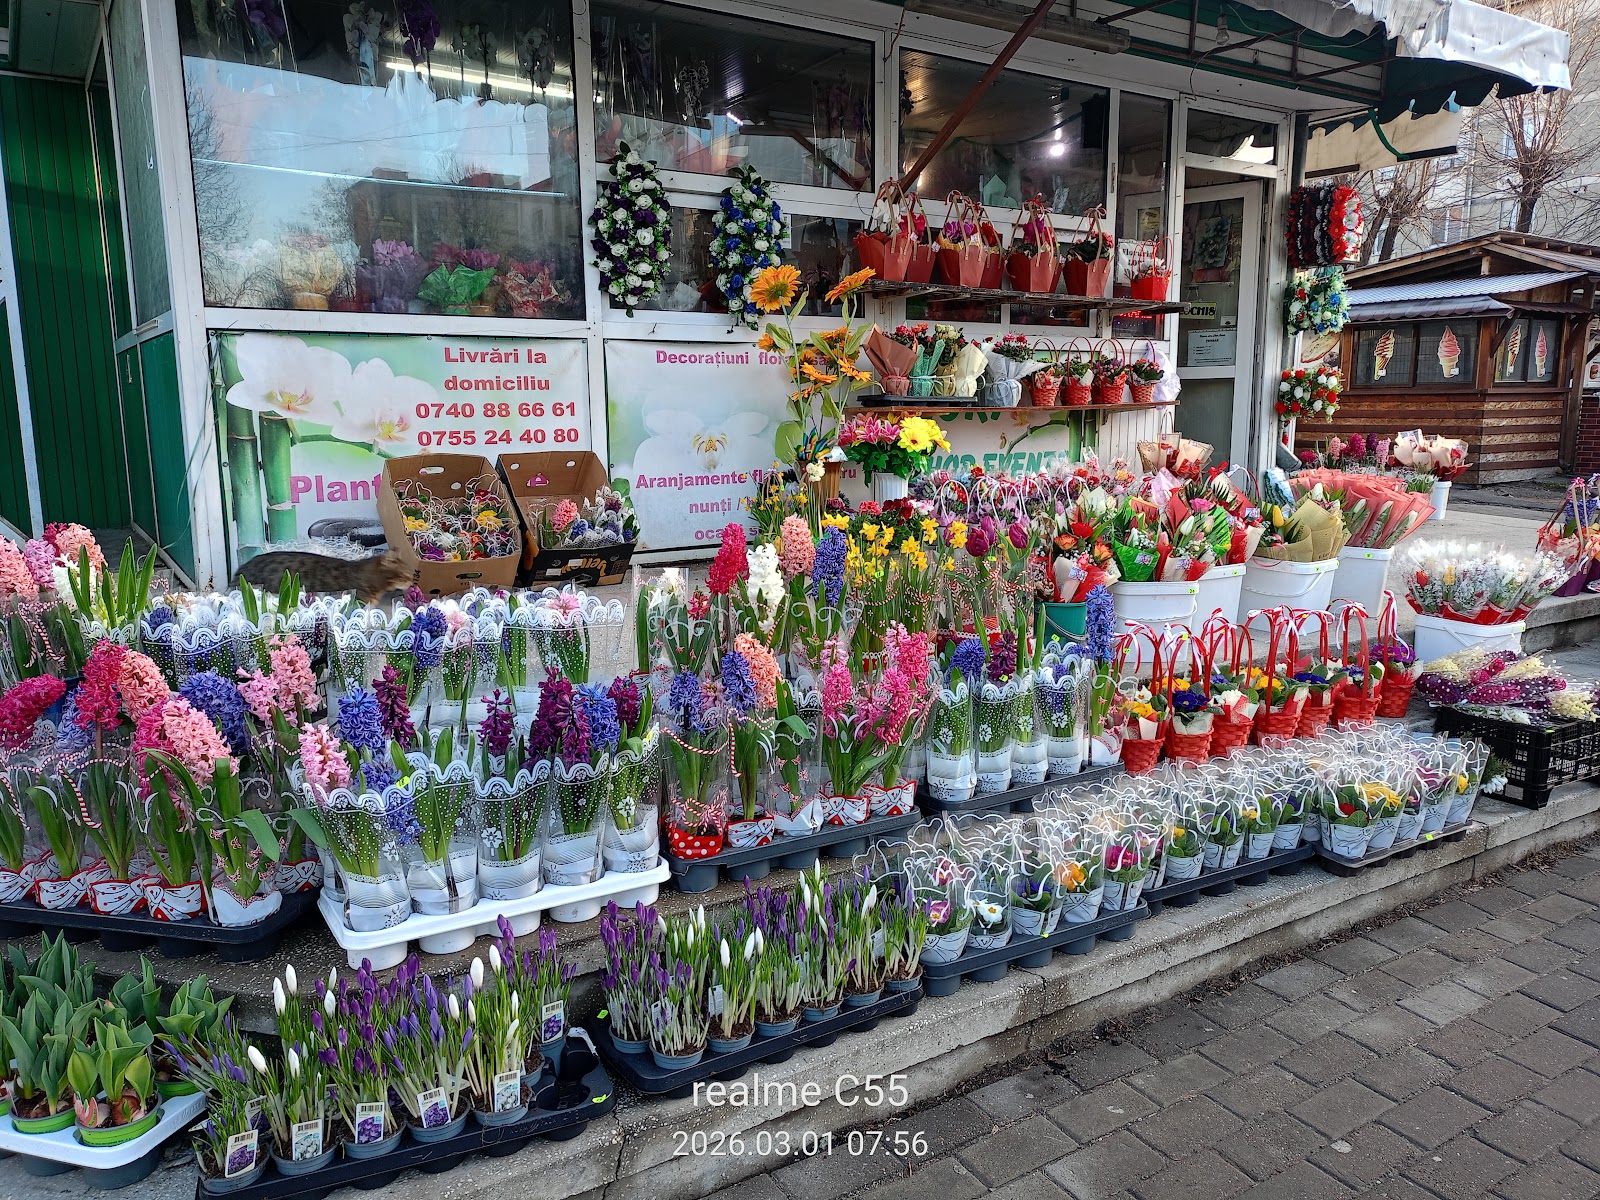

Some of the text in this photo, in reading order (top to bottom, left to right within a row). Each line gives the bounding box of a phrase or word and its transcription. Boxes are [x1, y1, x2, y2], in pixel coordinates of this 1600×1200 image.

[444, 347, 547, 364] Livrări la
[656, 350, 749, 368] Decorațiuni
[444, 375, 551, 391] domiciliu
[416, 401, 576, 419] 0740 88 66 61
[417, 428, 579, 447] 0755 24 40 80
[636, 470, 747, 490] Aranjamente
[689, 497, 731, 516] nunți
